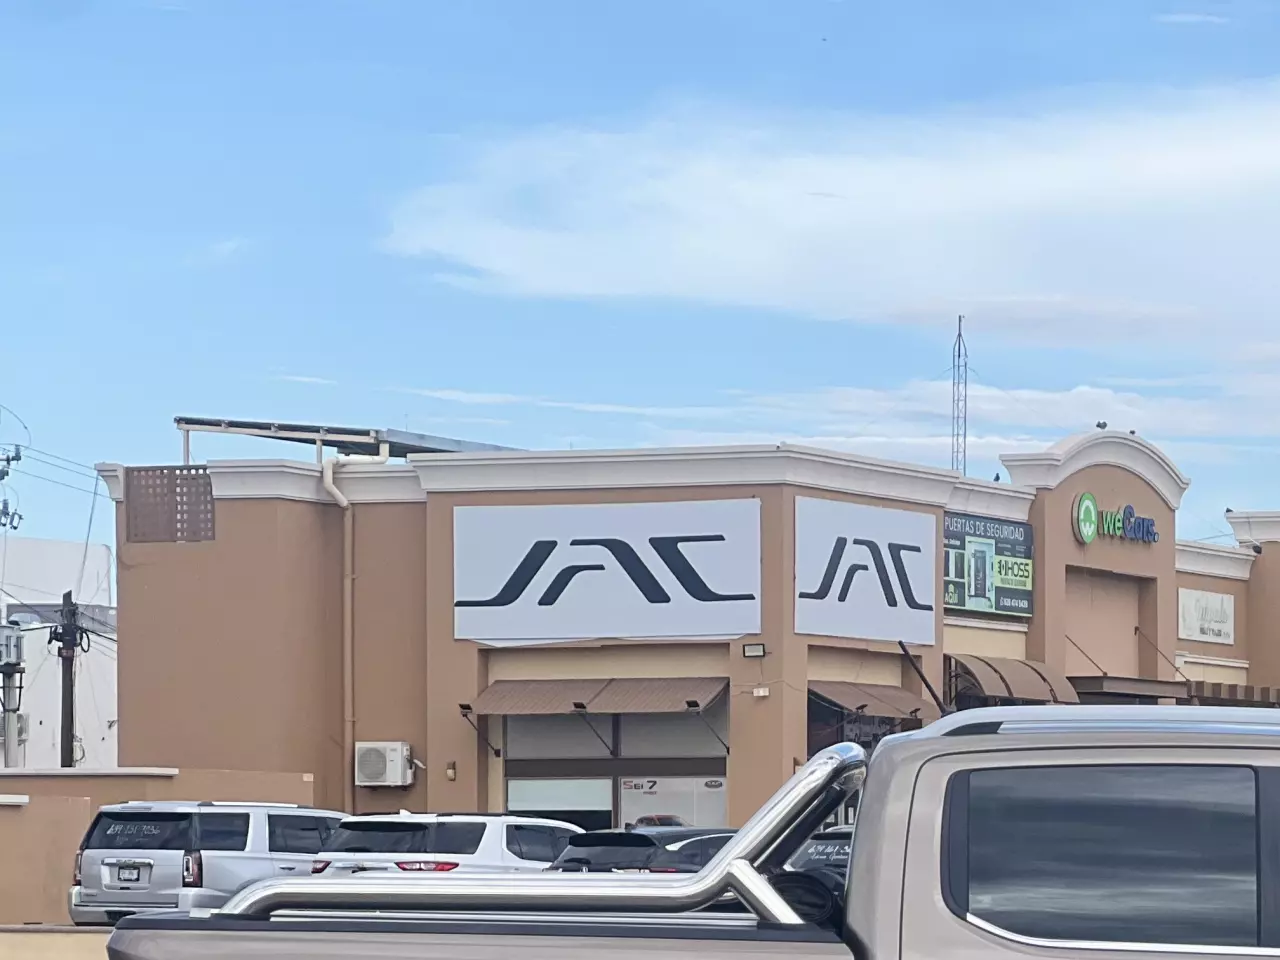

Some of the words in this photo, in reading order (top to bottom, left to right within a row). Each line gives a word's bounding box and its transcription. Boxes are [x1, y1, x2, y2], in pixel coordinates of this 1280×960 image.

[945, 517, 974, 534] PUERTAS
[976, 521, 985, 535] DE
[987, 523, 1024, 540] SEGURIDAD
[454, 535, 756, 606] JAC
[799, 537, 934, 611] JAC
[647, 781, 657, 790] 7
